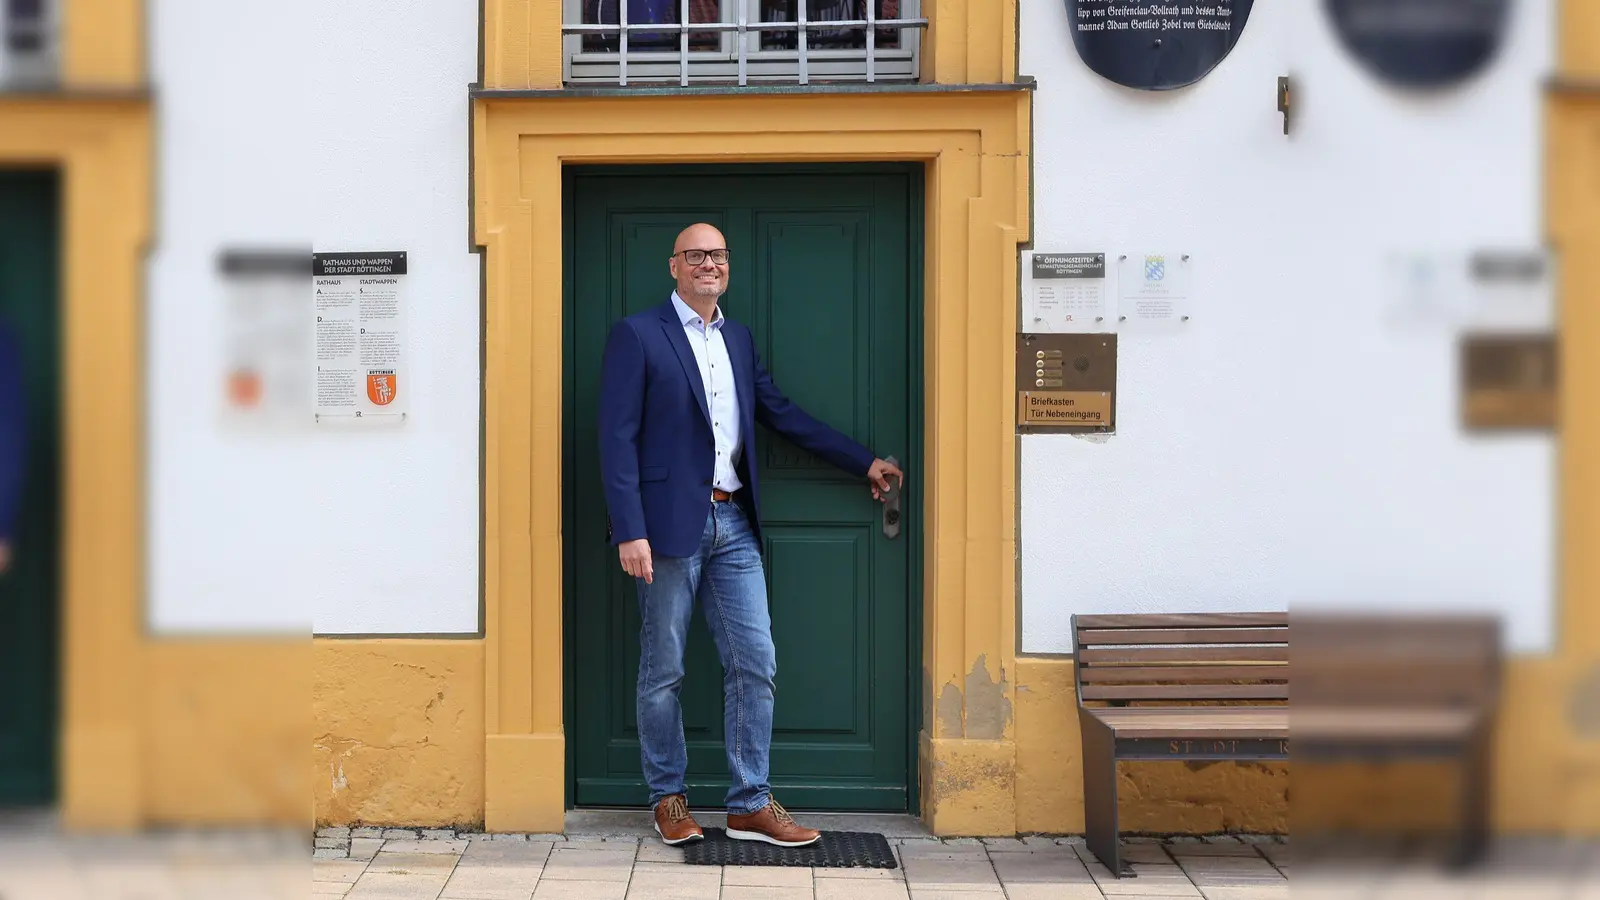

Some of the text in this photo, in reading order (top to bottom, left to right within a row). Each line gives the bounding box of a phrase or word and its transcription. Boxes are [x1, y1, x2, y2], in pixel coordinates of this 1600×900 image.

[1092, 7, 1106, 17] von
[1181, 5, 1194, 15] und
[1195, 5, 1216, 16] dessen
[1077, 18, 1231, 31] mannes Adam Gottlieb Zobel von Giebelstadt
[1044, 255, 1094, 264] ÖFFNUNGSZEITEN
[356, 265, 392, 273] RÖTTINGEN
[1031, 397, 1075, 406] Briefkasten
[1031, 409, 1101, 420] Tür Nebeneingang
[1169, 740, 1240, 754] STDT
